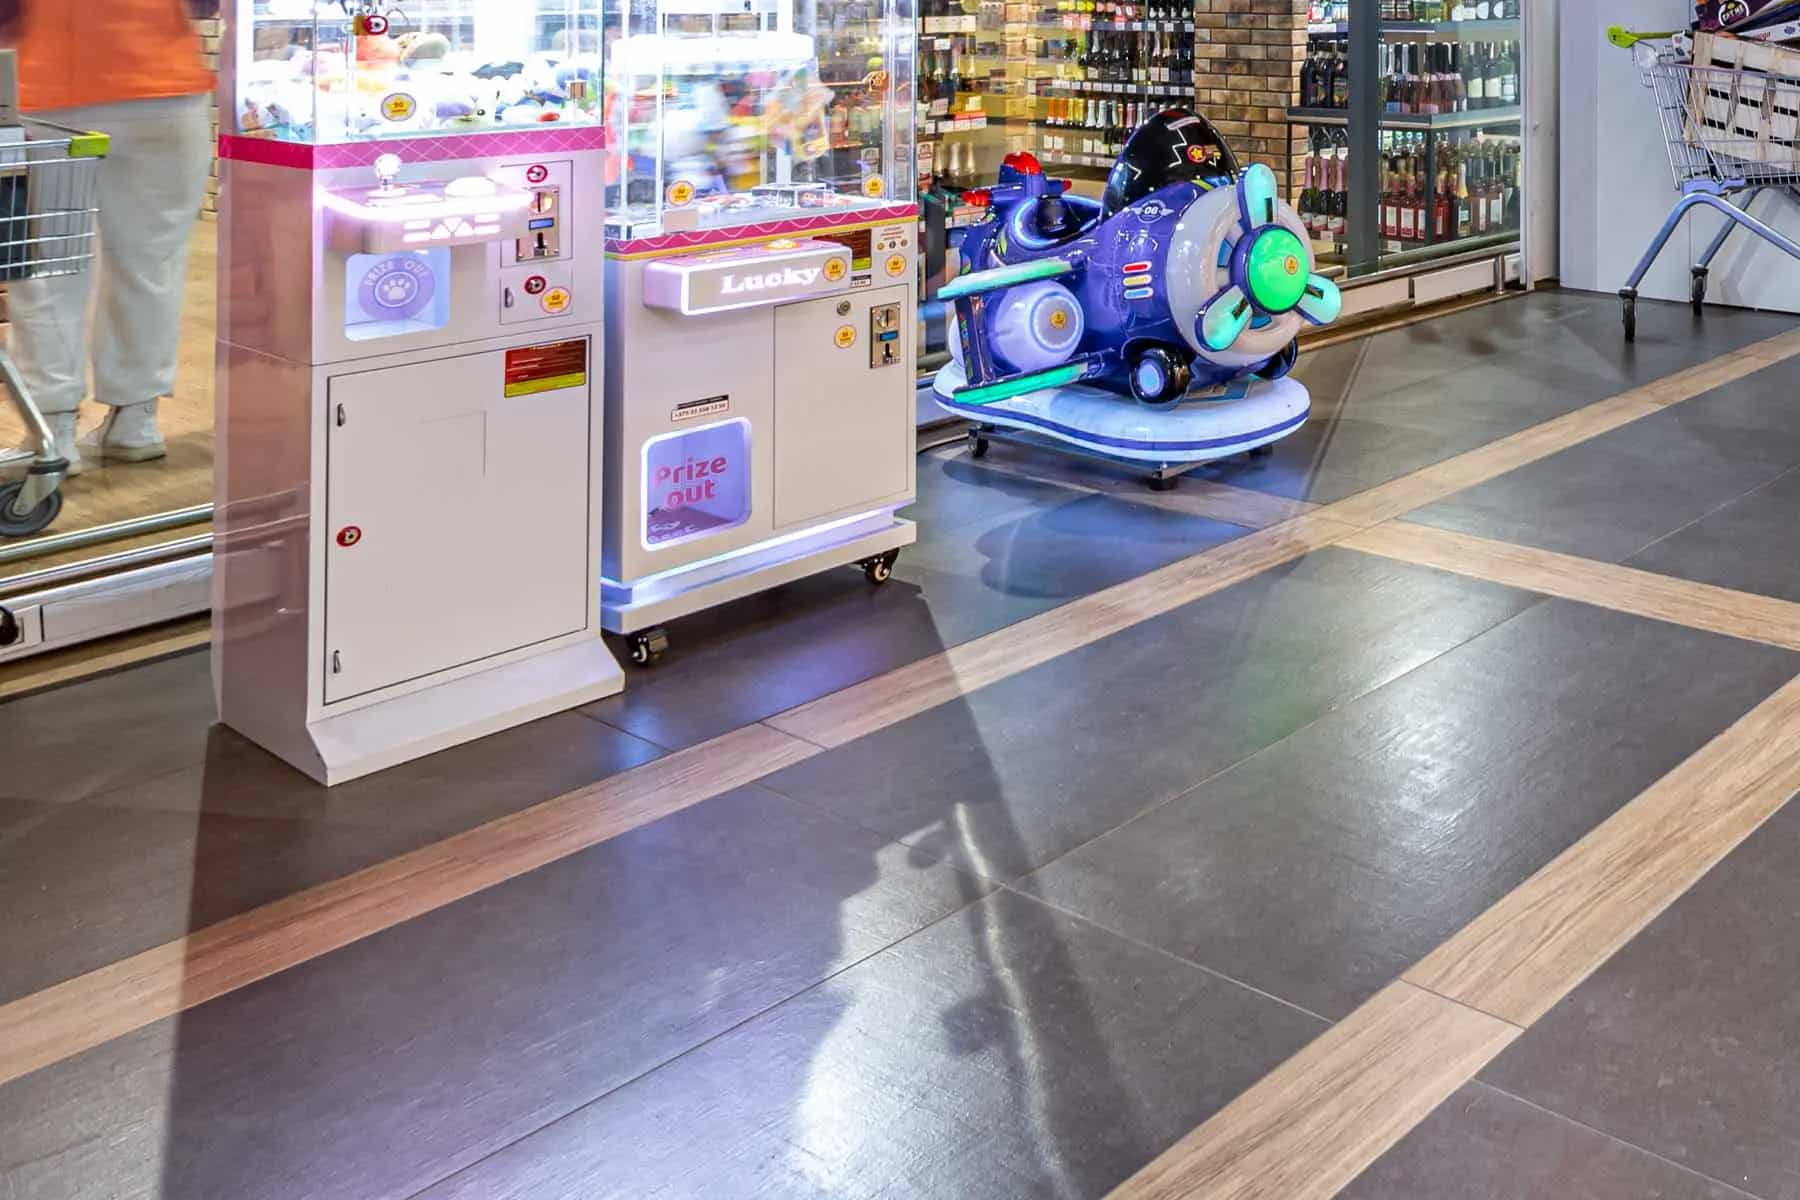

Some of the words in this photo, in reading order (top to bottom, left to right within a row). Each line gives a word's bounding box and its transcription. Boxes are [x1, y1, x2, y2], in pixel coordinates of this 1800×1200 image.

[720, 266, 822, 295] Lucky
[654, 455, 728, 486] Prize
[666, 480, 716, 509] out
